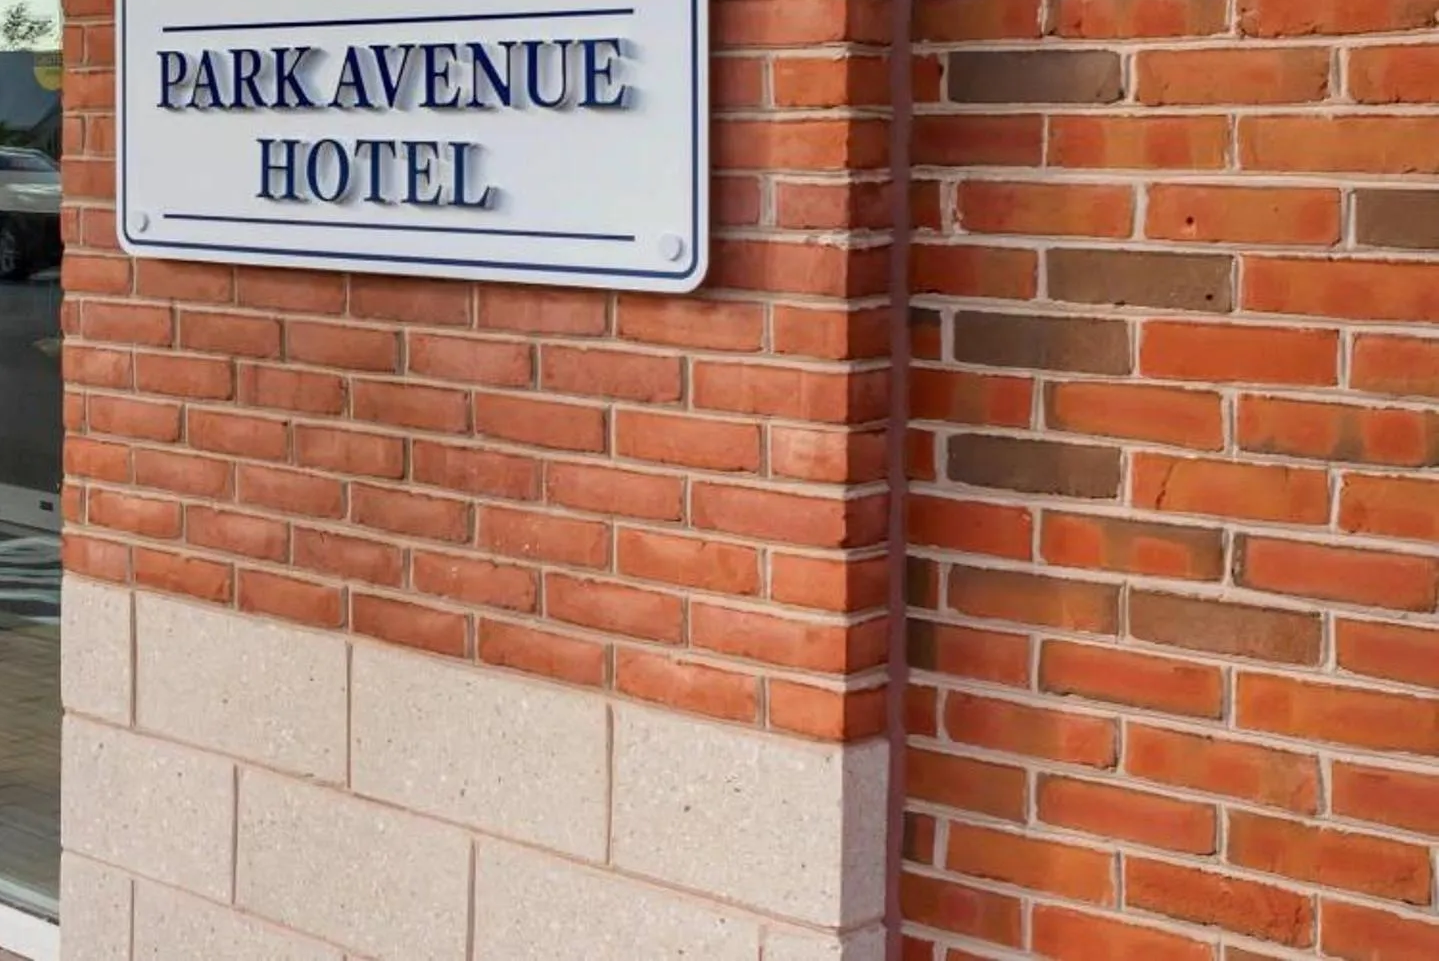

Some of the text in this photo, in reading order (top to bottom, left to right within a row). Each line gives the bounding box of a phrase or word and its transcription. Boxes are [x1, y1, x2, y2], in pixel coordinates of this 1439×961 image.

[157, 38, 629, 110] PARK AVENUE
[256, 139, 496, 209] HOTEL
